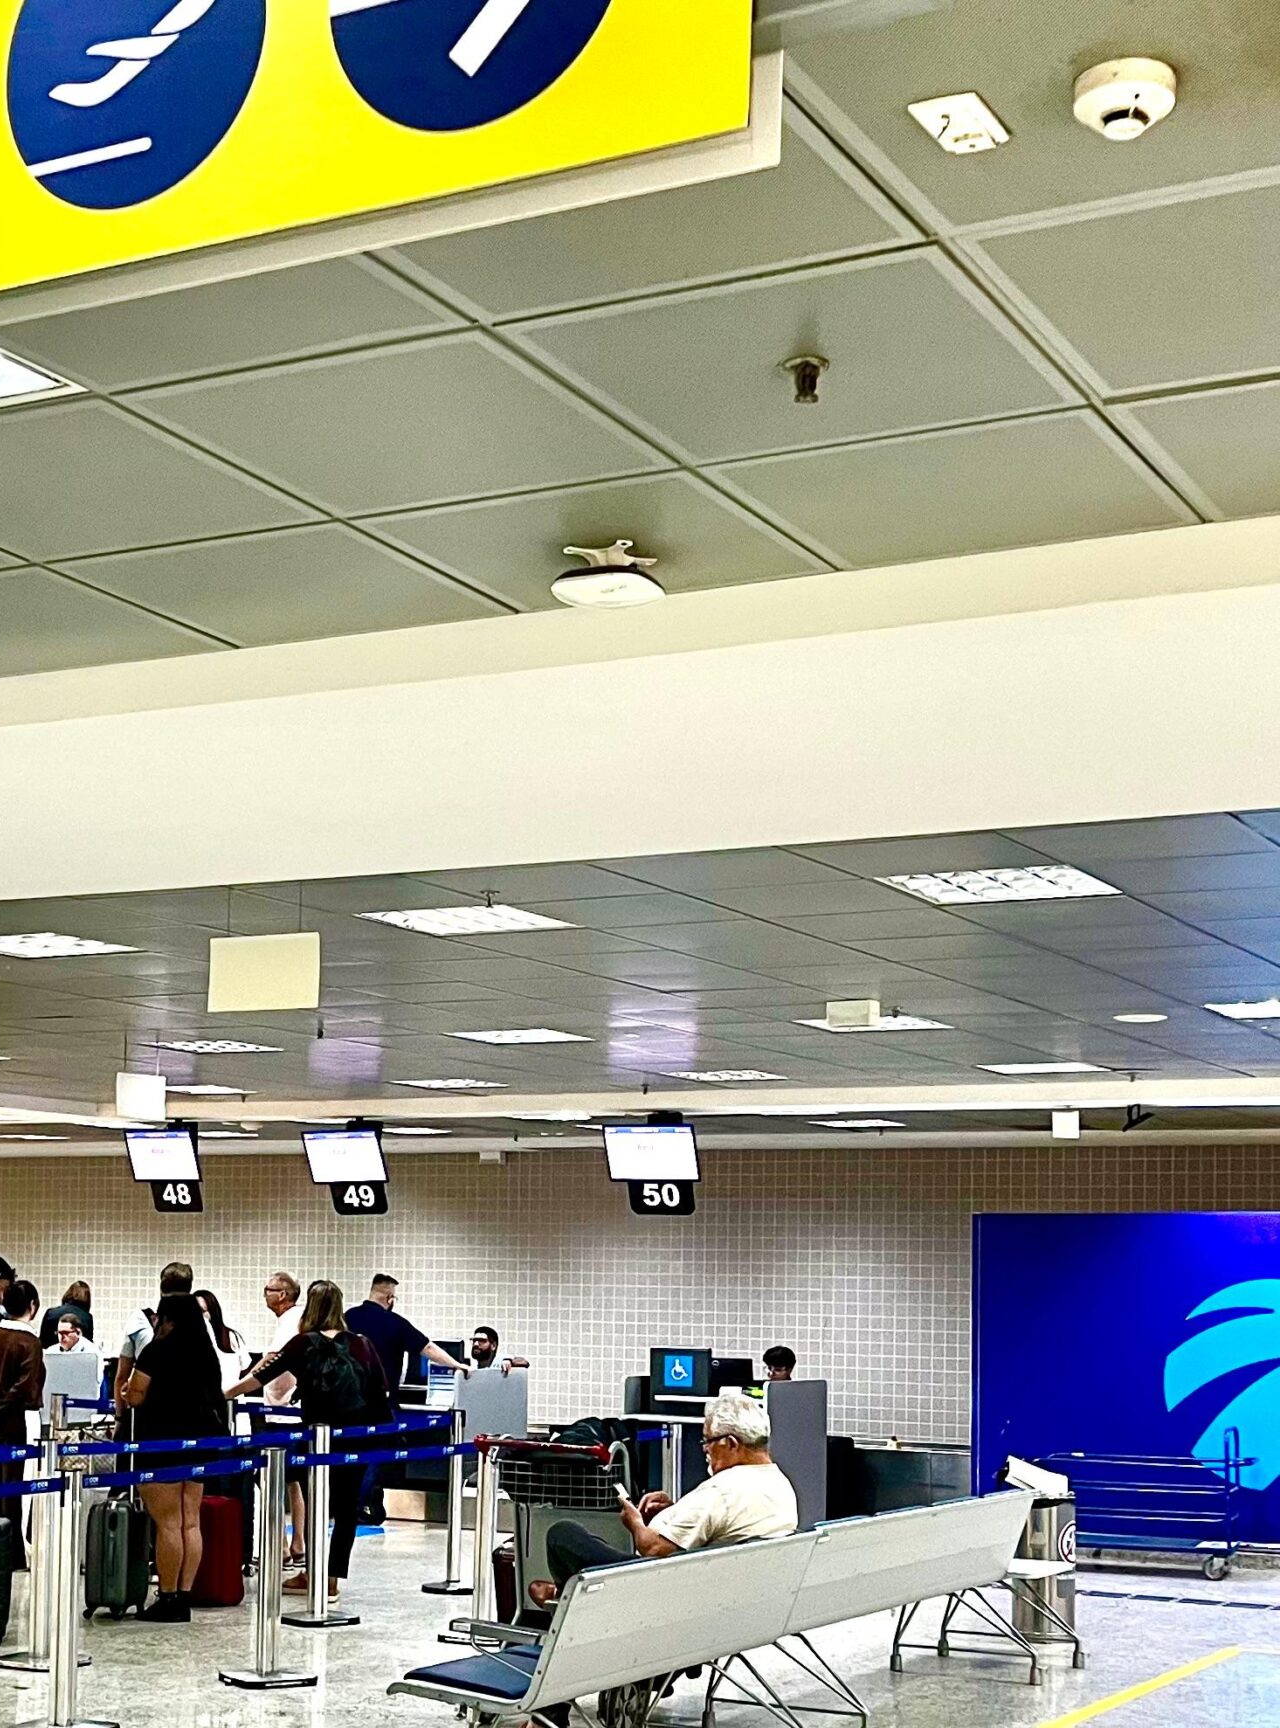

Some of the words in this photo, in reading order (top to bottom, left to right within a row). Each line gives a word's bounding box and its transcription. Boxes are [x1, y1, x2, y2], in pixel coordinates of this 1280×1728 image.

[163, 1183, 192, 1205] 48
[343, 1185, 375, 1207] 49
[642, 1183, 680, 1207] 50
